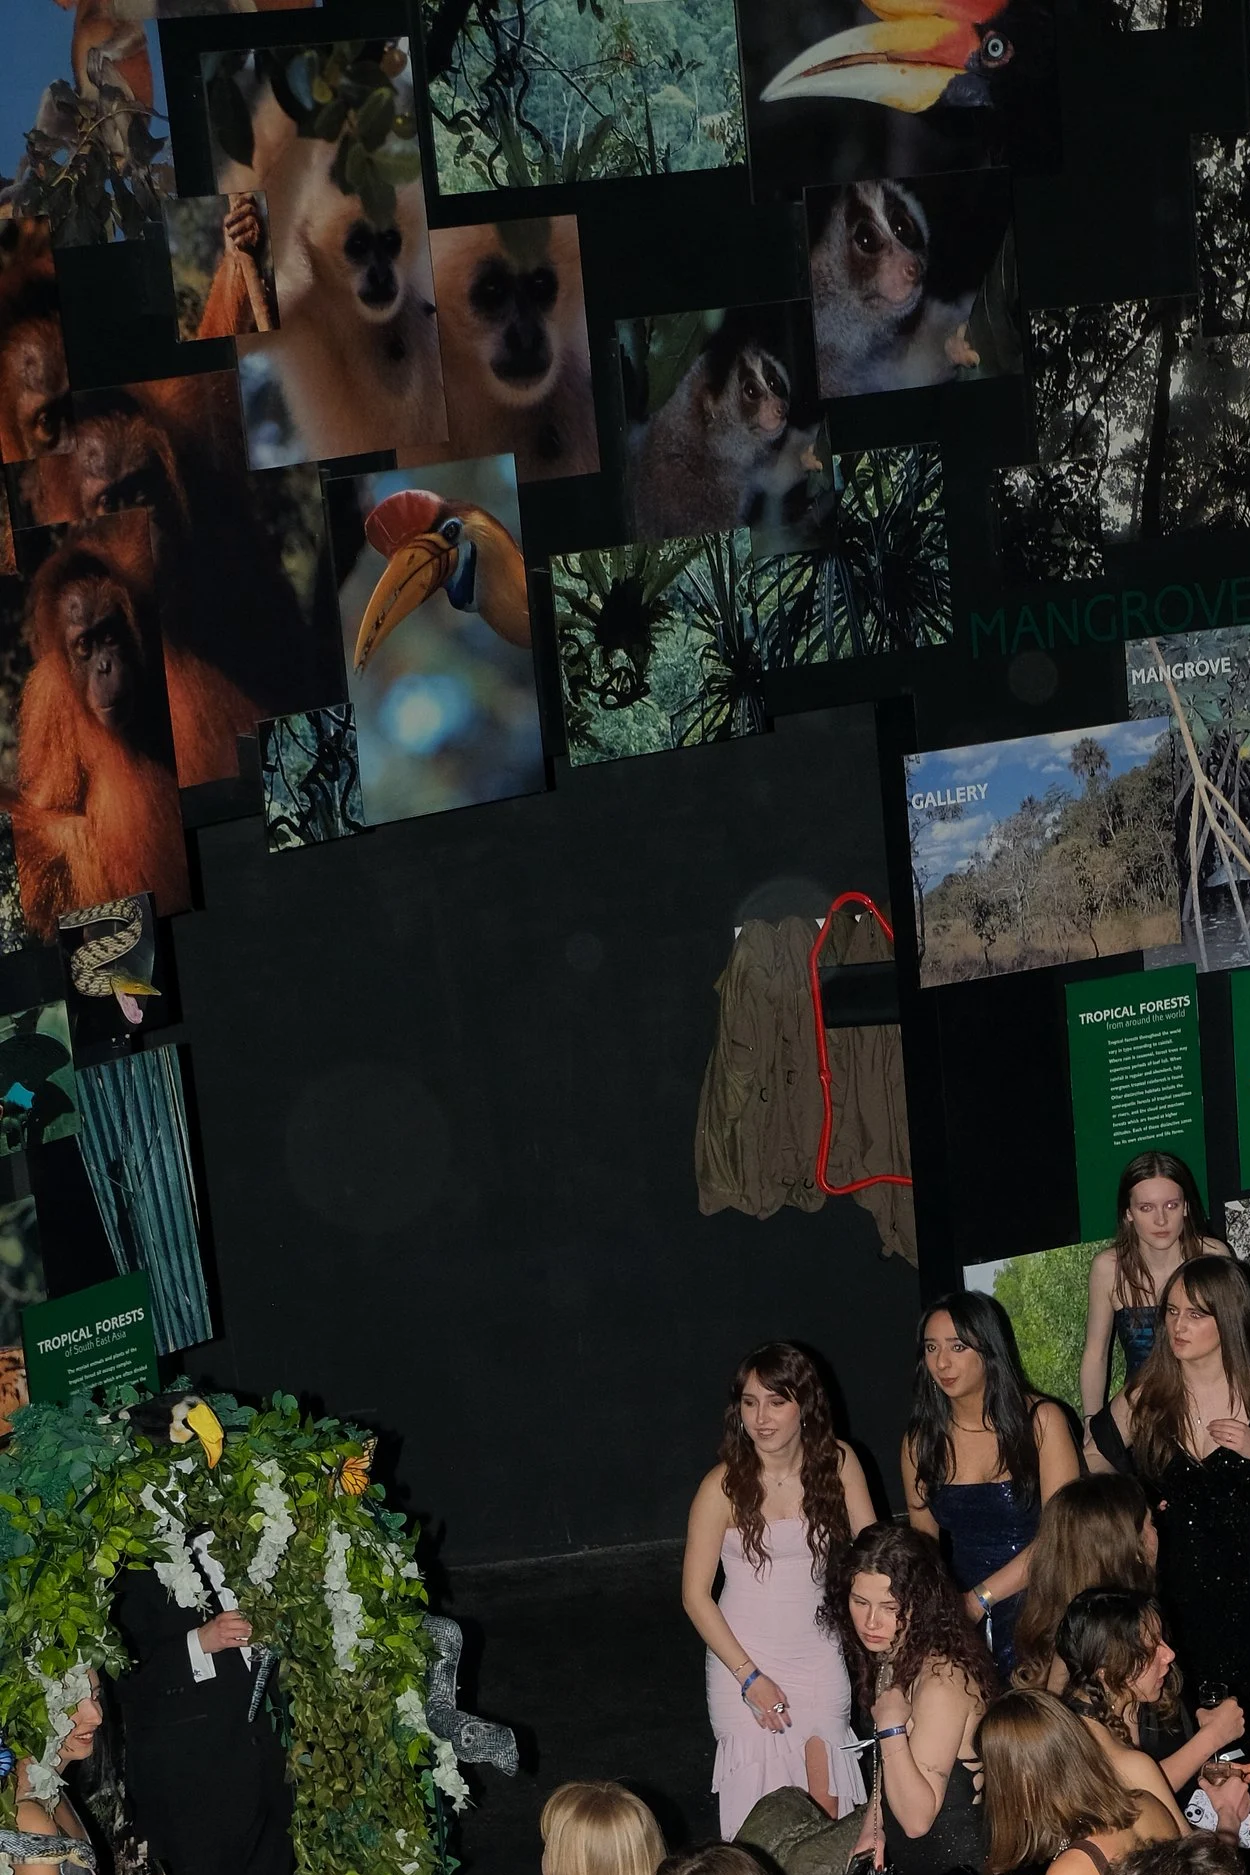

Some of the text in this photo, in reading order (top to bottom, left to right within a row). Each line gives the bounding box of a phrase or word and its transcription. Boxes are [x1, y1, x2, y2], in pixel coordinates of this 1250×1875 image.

[1131, 657, 1231, 685] MANGROVE
[911, 782, 988, 810] GALLERY
[1079, 995, 1190, 1025] TROPICAL FORESTS
[1106, 1009, 1186, 1030] from around the world
[37, 1307, 144, 1354] TROPICAL FORESTS
[64, 1330, 126, 1358] of South East Asia
